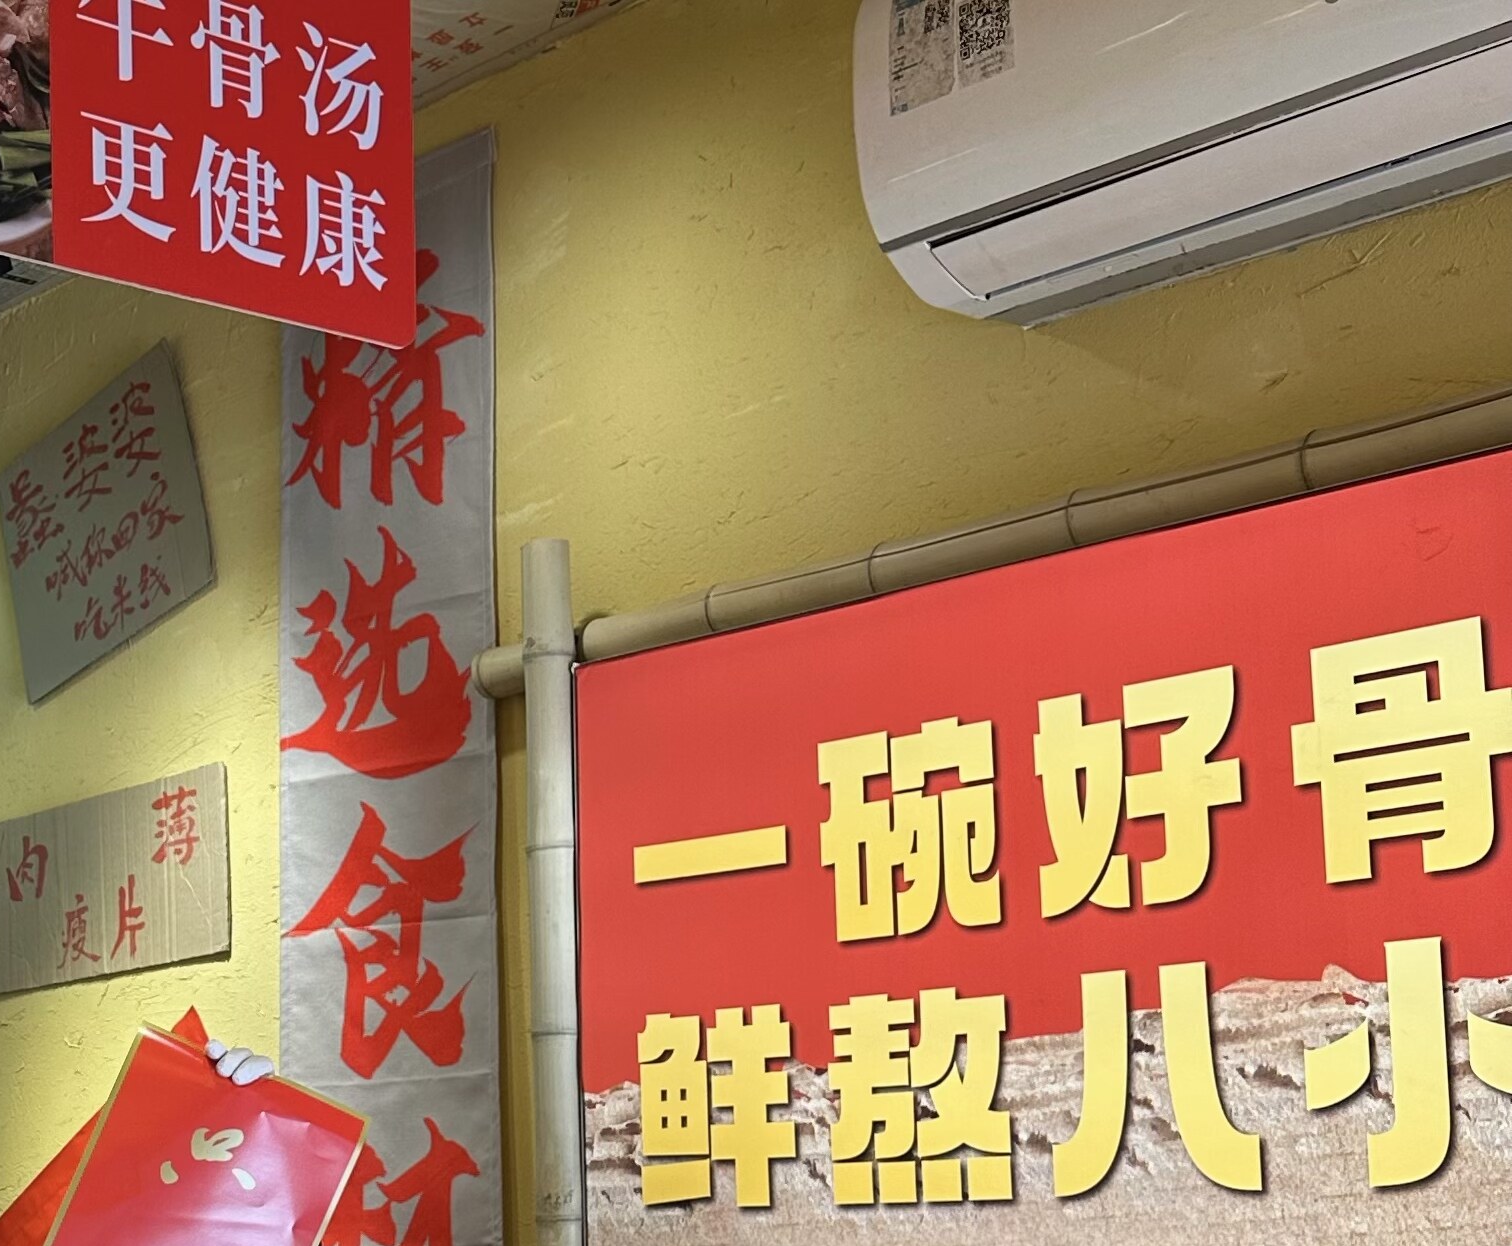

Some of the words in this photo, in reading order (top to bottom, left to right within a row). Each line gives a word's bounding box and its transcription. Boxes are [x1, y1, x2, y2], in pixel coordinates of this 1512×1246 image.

[79, 110, 389, 291] 更健康
[74, 554, 171, 642] 吃米线
[633, 615, 1512, 943] 一碗好骨
[637, 936, 1512, 1207] 鲜熬八小
